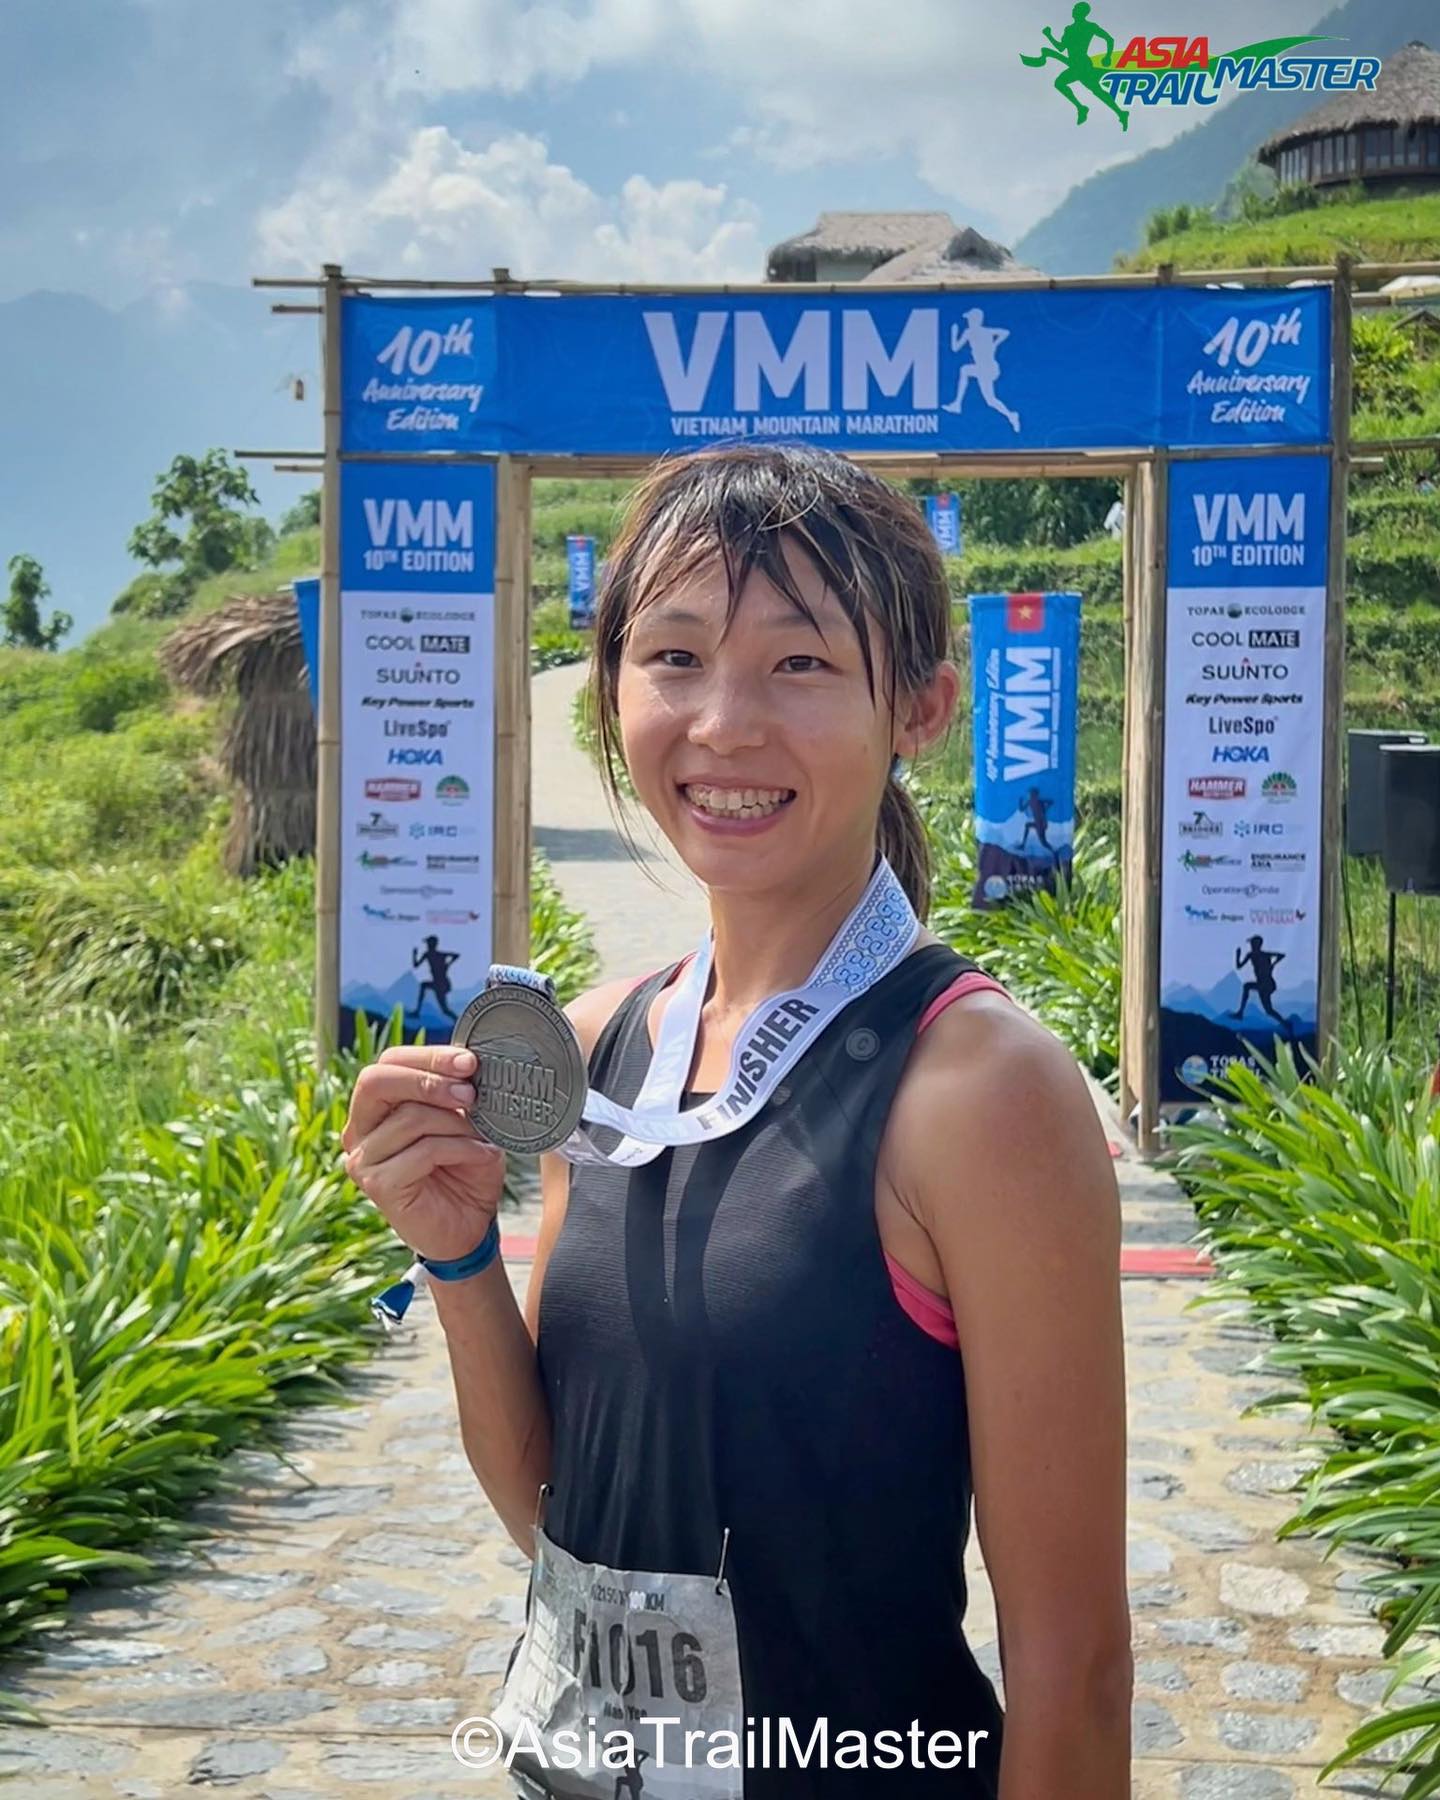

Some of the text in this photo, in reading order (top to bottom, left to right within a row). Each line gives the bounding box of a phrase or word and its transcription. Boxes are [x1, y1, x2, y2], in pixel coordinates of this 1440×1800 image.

[377, 318, 473, 376] 10th
[1203, 307, 1302, 368] 10th
[642, 308, 940, 412] VMM
[362, 377, 484, 413] Anniversary
[1187, 369, 1310, 405] Anniversary
[386, 406, 460, 431] Edition
[1211, 399, 1286, 424] Edition
[671, 414, 939, 436] VIETNAM MOUNTAIN MARATHON
[363, 498, 474, 548] VMM
[1193, 493, 1305, 543] VMM
[402, 550, 475, 572] EDITION
[1232, 544, 1305, 566] EDITION
[365, 635, 468, 652] COOL MATE
[1191, 631, 1297, 647] COOL MATE
[376, 668, 461, 684] SUUNTO
[1201, 664, 1289, 681] SUUNTO
[1003, 647, 1052, 783] VMM
[388, 748, 443, 765] HOKA
[1212, 746, 1270, 763] HOKA
[1189, 778, 1244, 792] HAMMER
[1252, 823, 1284, 836] IRC
[696, 997, 821, 1131] FINISHER
[480, 1088, 553, 1129] FINISHER
